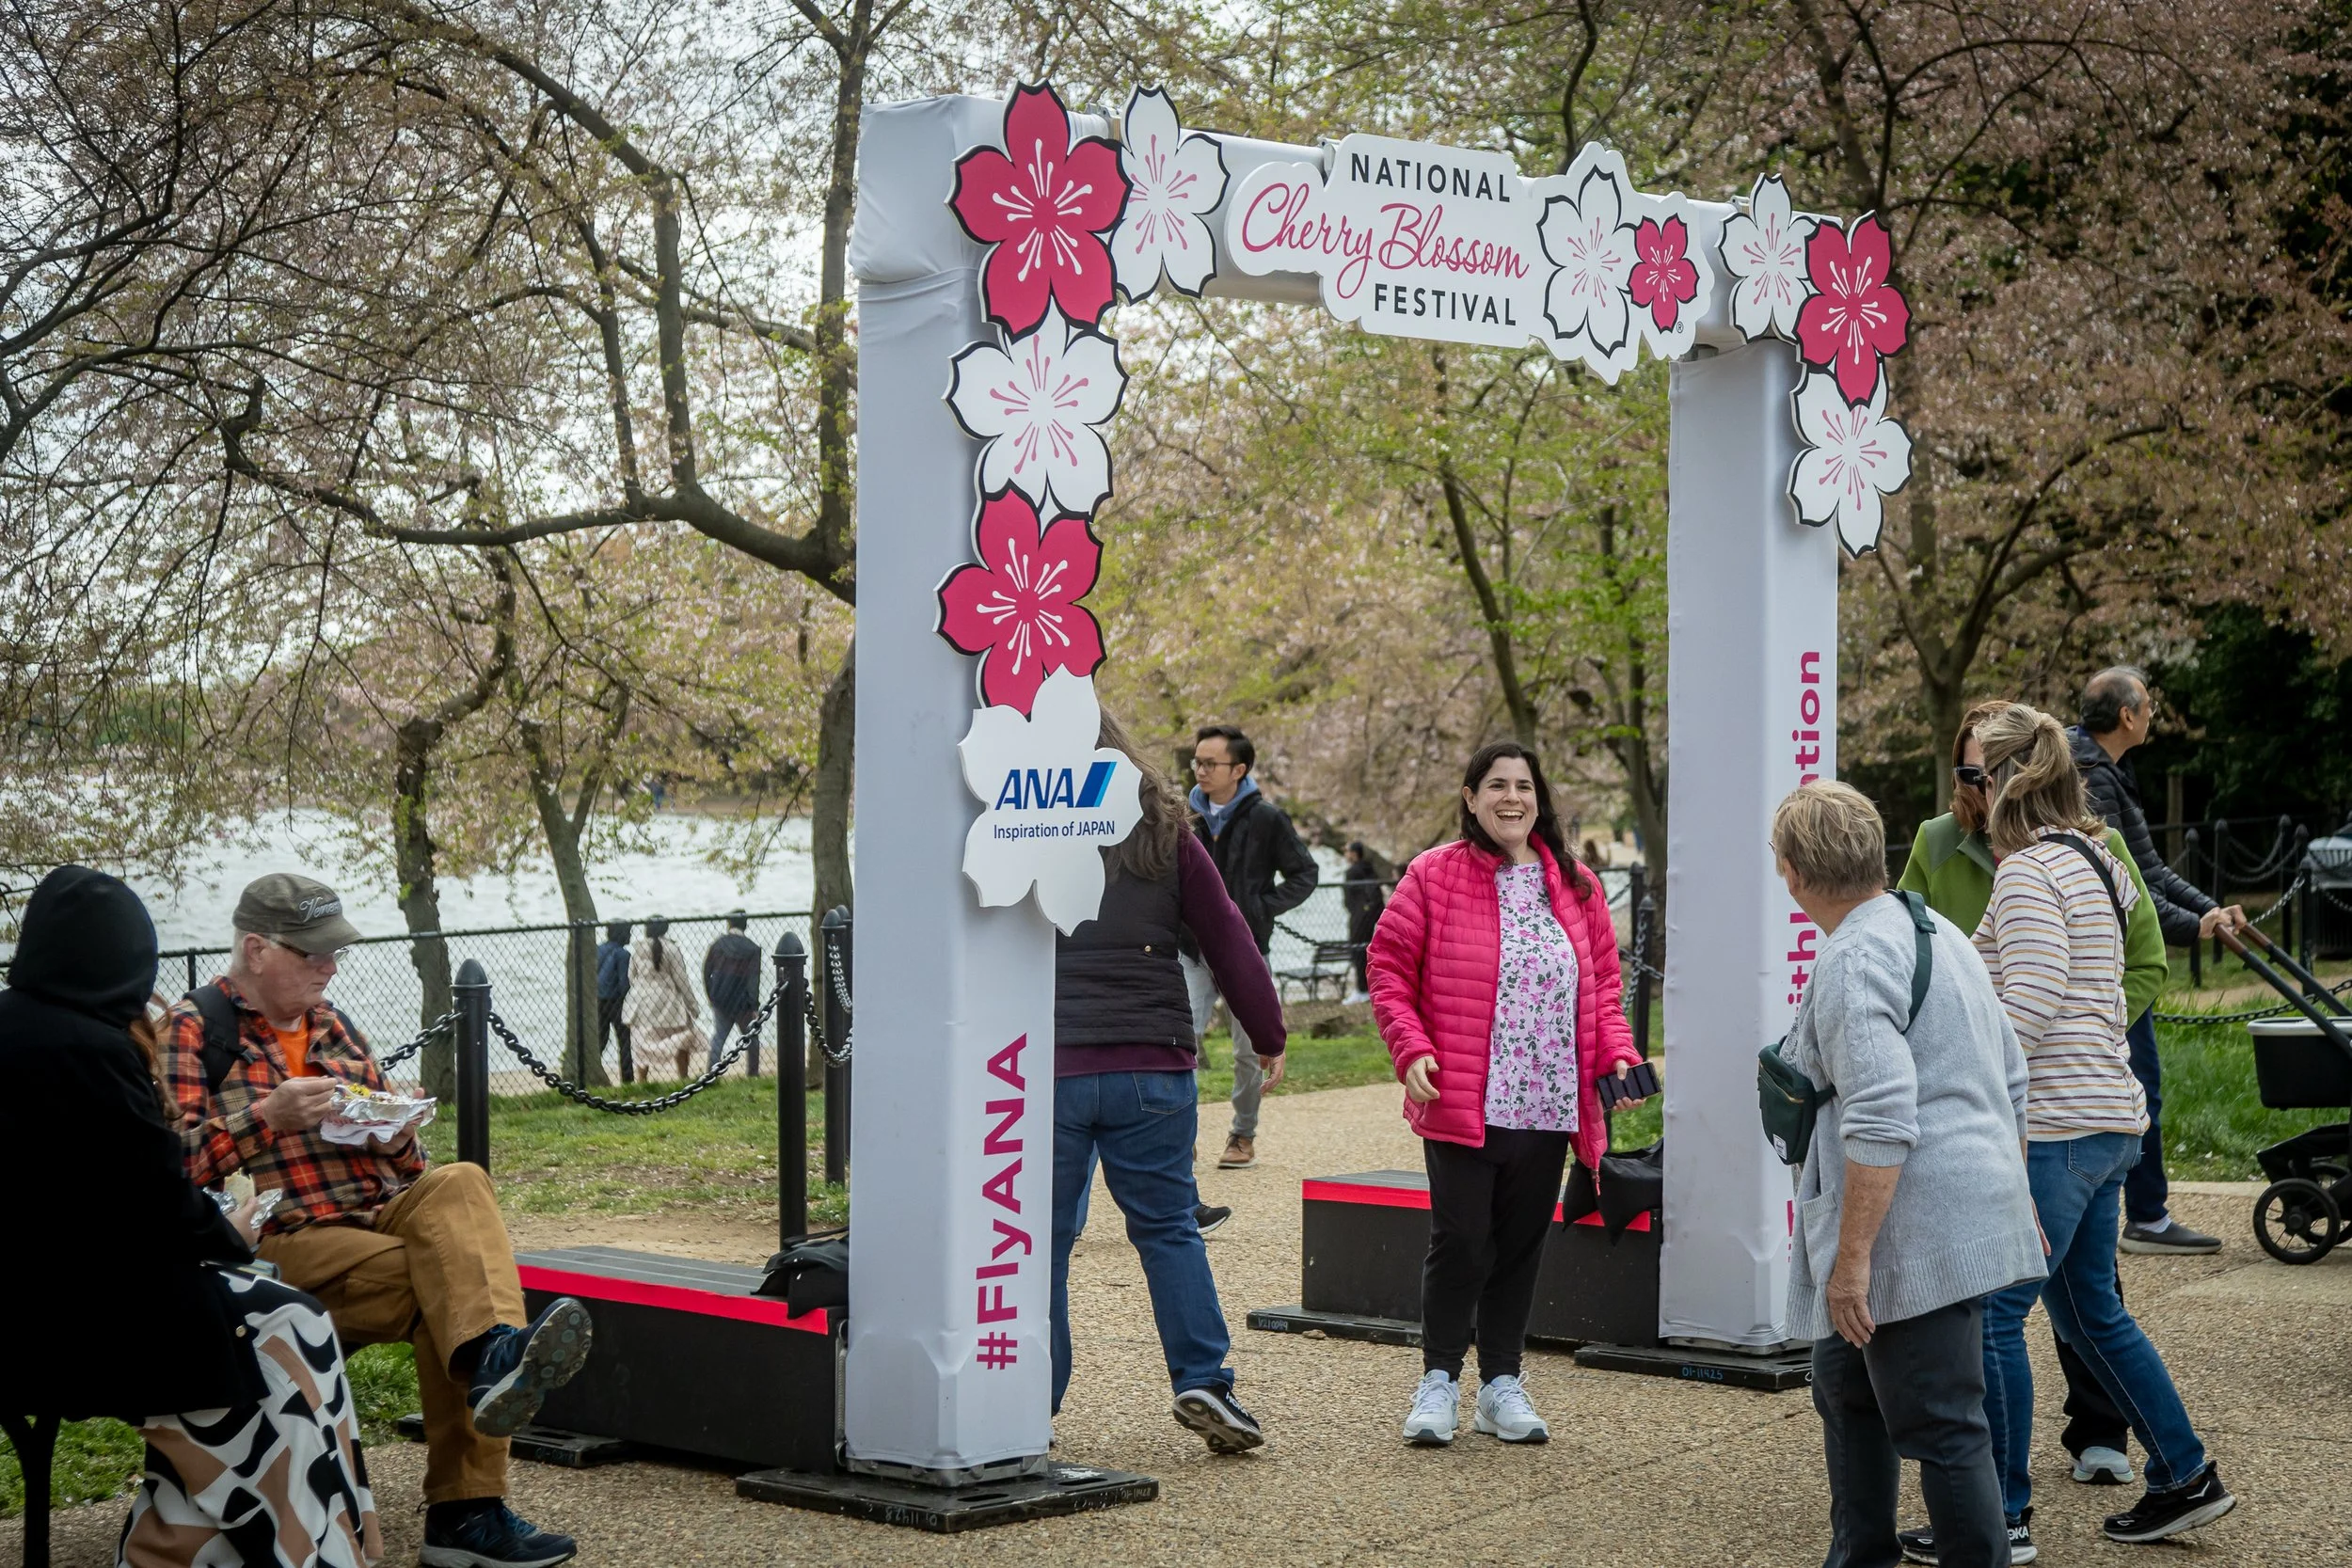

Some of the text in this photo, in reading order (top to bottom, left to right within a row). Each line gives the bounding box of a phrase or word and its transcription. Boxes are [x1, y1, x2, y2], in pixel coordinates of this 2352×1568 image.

[1351, 152, 1510, 203] NATIONAL
[1242, 182, 1530, 300] Cherry Blossom
[1374, 282, 1517, 326] FESTIVAL
[994, 768, 1074, 810] ANA
[993, 820, 1116, 841] Inspiration of JAPAN
[976, 1032, 1032, 1370] #FlyANA
[2007, 1525, 2029, 1541] OKA
